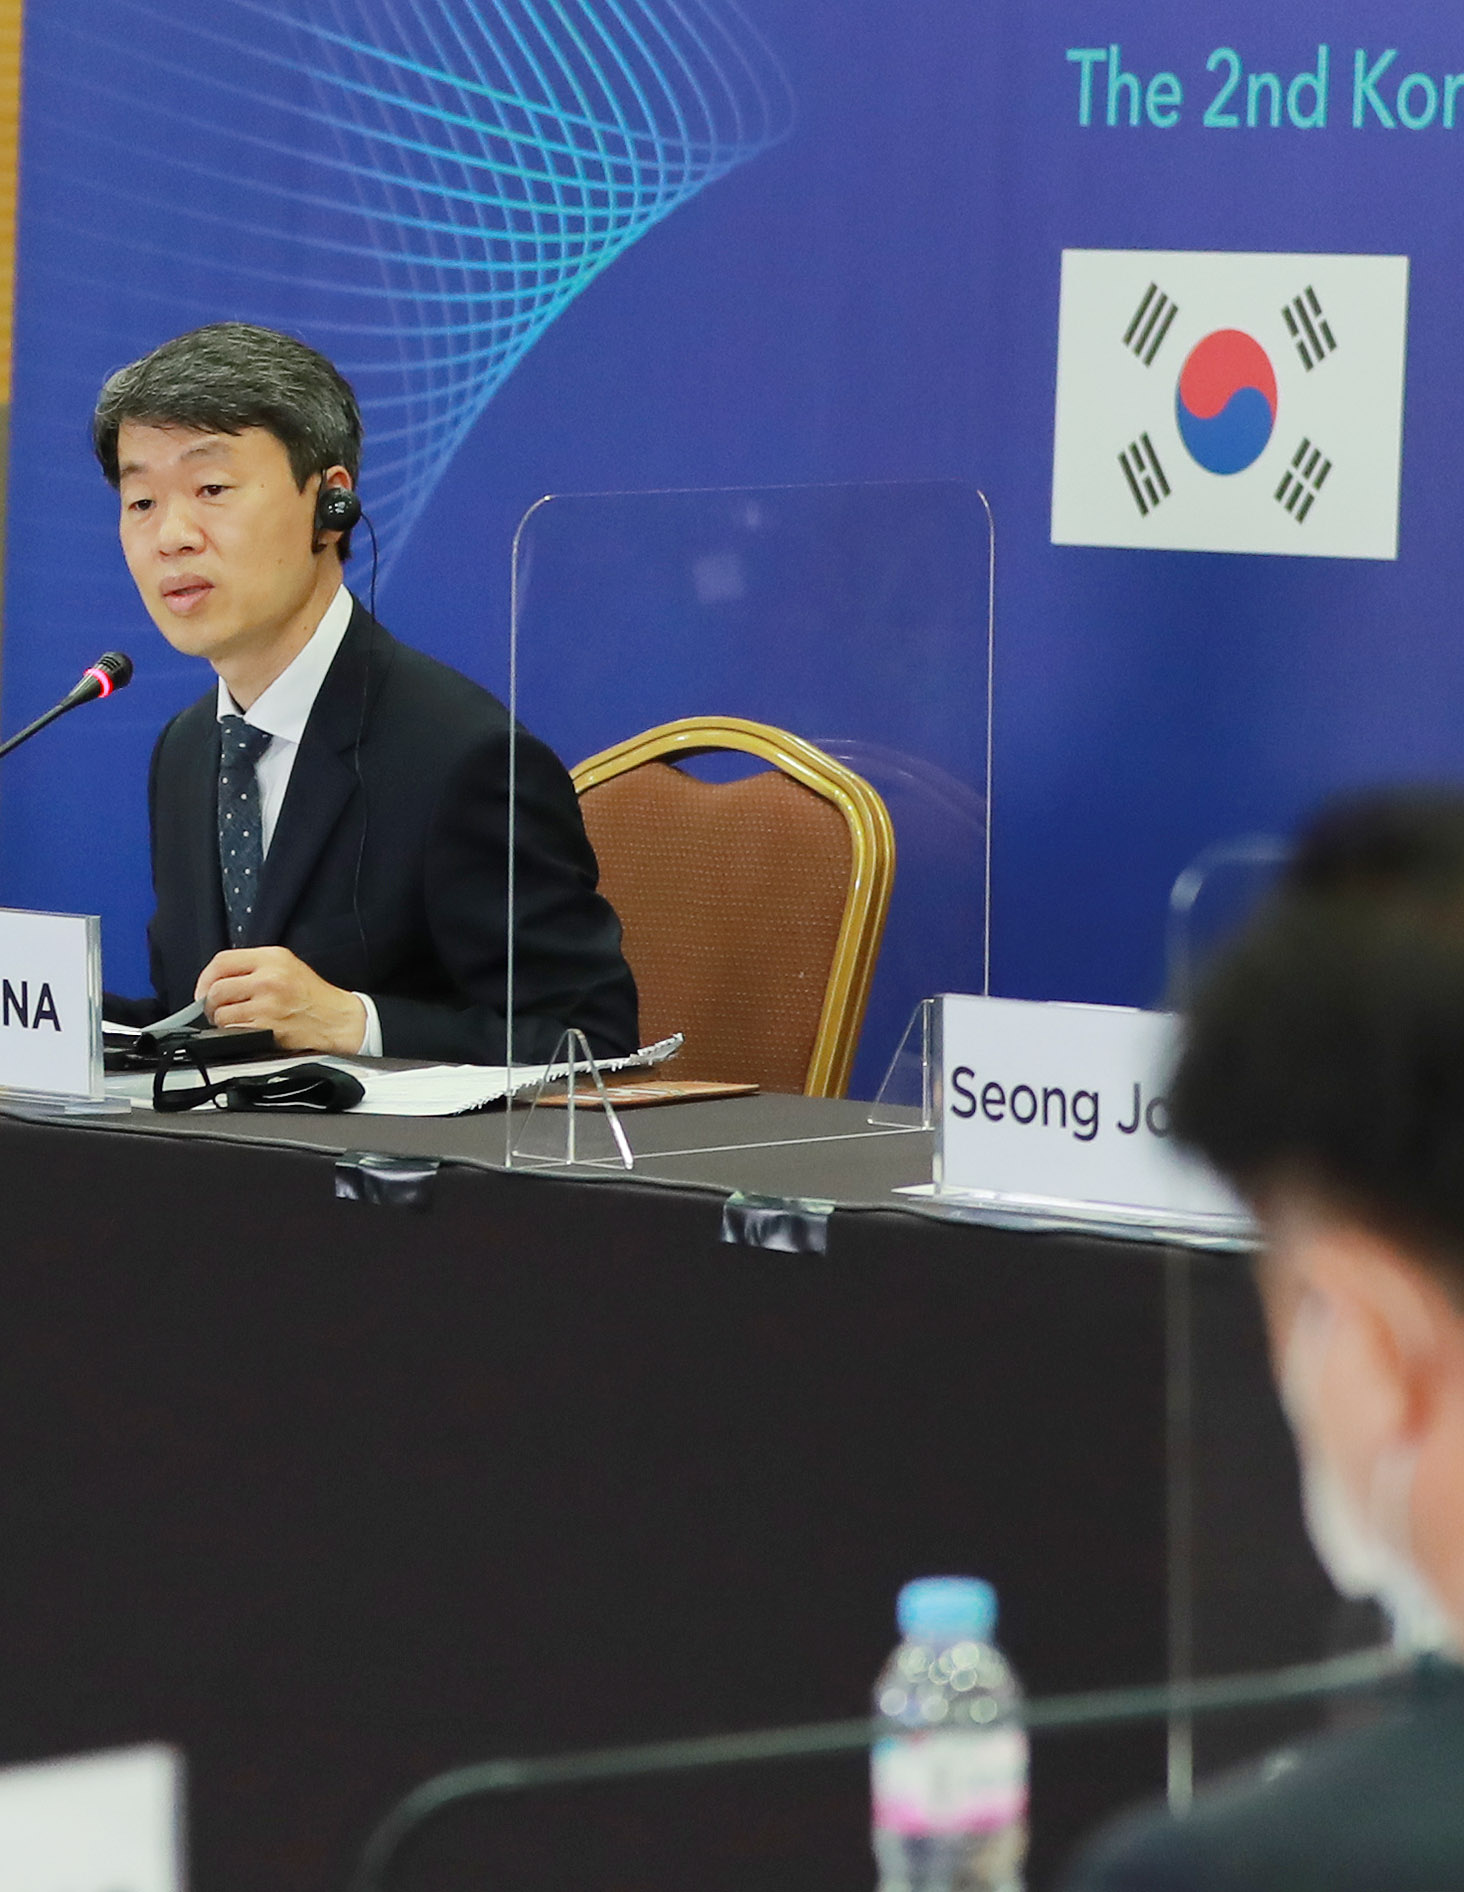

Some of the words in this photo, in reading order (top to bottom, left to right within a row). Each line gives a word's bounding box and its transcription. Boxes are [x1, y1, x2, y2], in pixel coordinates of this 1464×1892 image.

[1066, 44, 1183, 128] The
[1203, 43, 1329, 129] 2nd
[2, 979, 62, 1032] NA
[950, 1066, 1099, 1142] Seong
